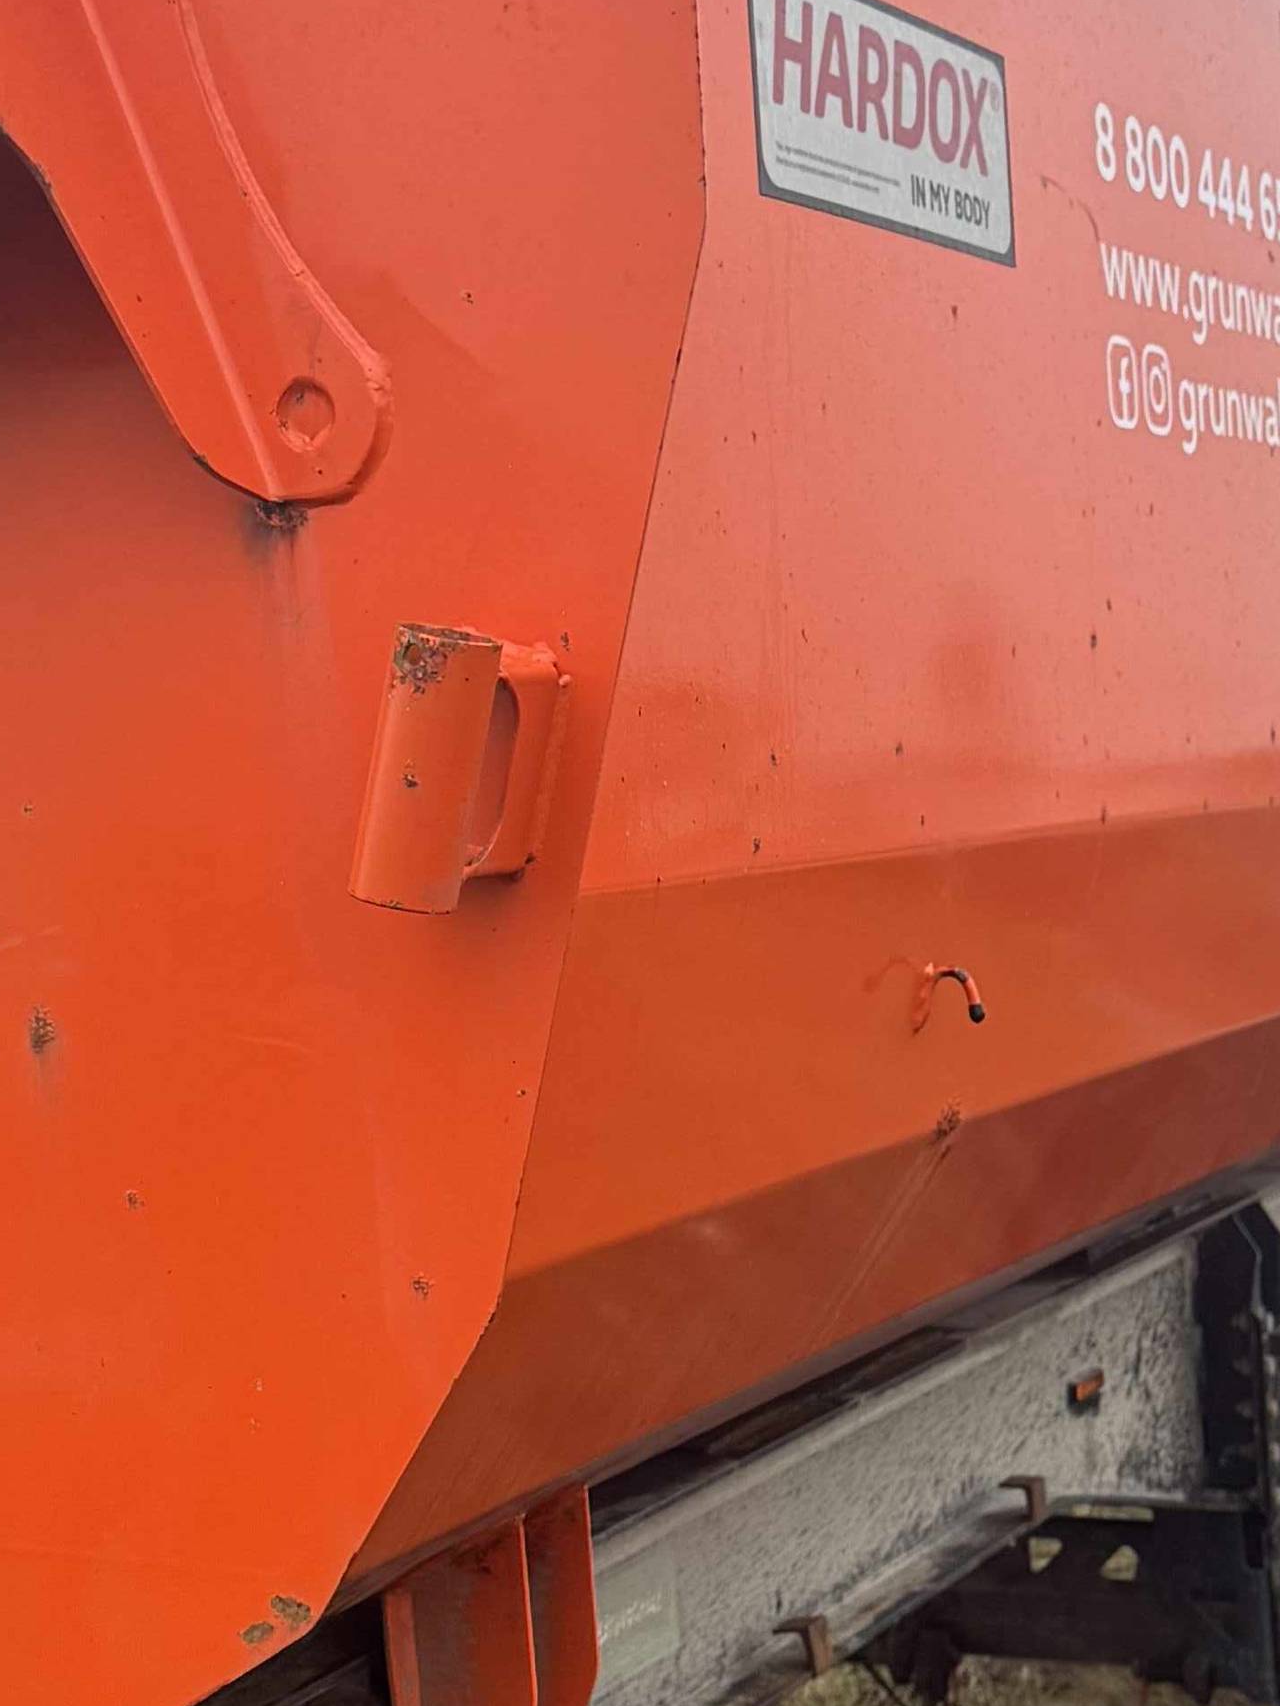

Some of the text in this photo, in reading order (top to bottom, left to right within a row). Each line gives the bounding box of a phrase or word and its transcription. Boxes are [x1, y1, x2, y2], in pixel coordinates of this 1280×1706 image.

[911, 174, 927, 207] IN
[930, 180, 951, 216] MY
[954, 190, 990, 229] BODY
[1095, 102, 1116, 181] 8
[1125, 115, 1190, 208] 800
[1197, 149, 1253, 231] 444
